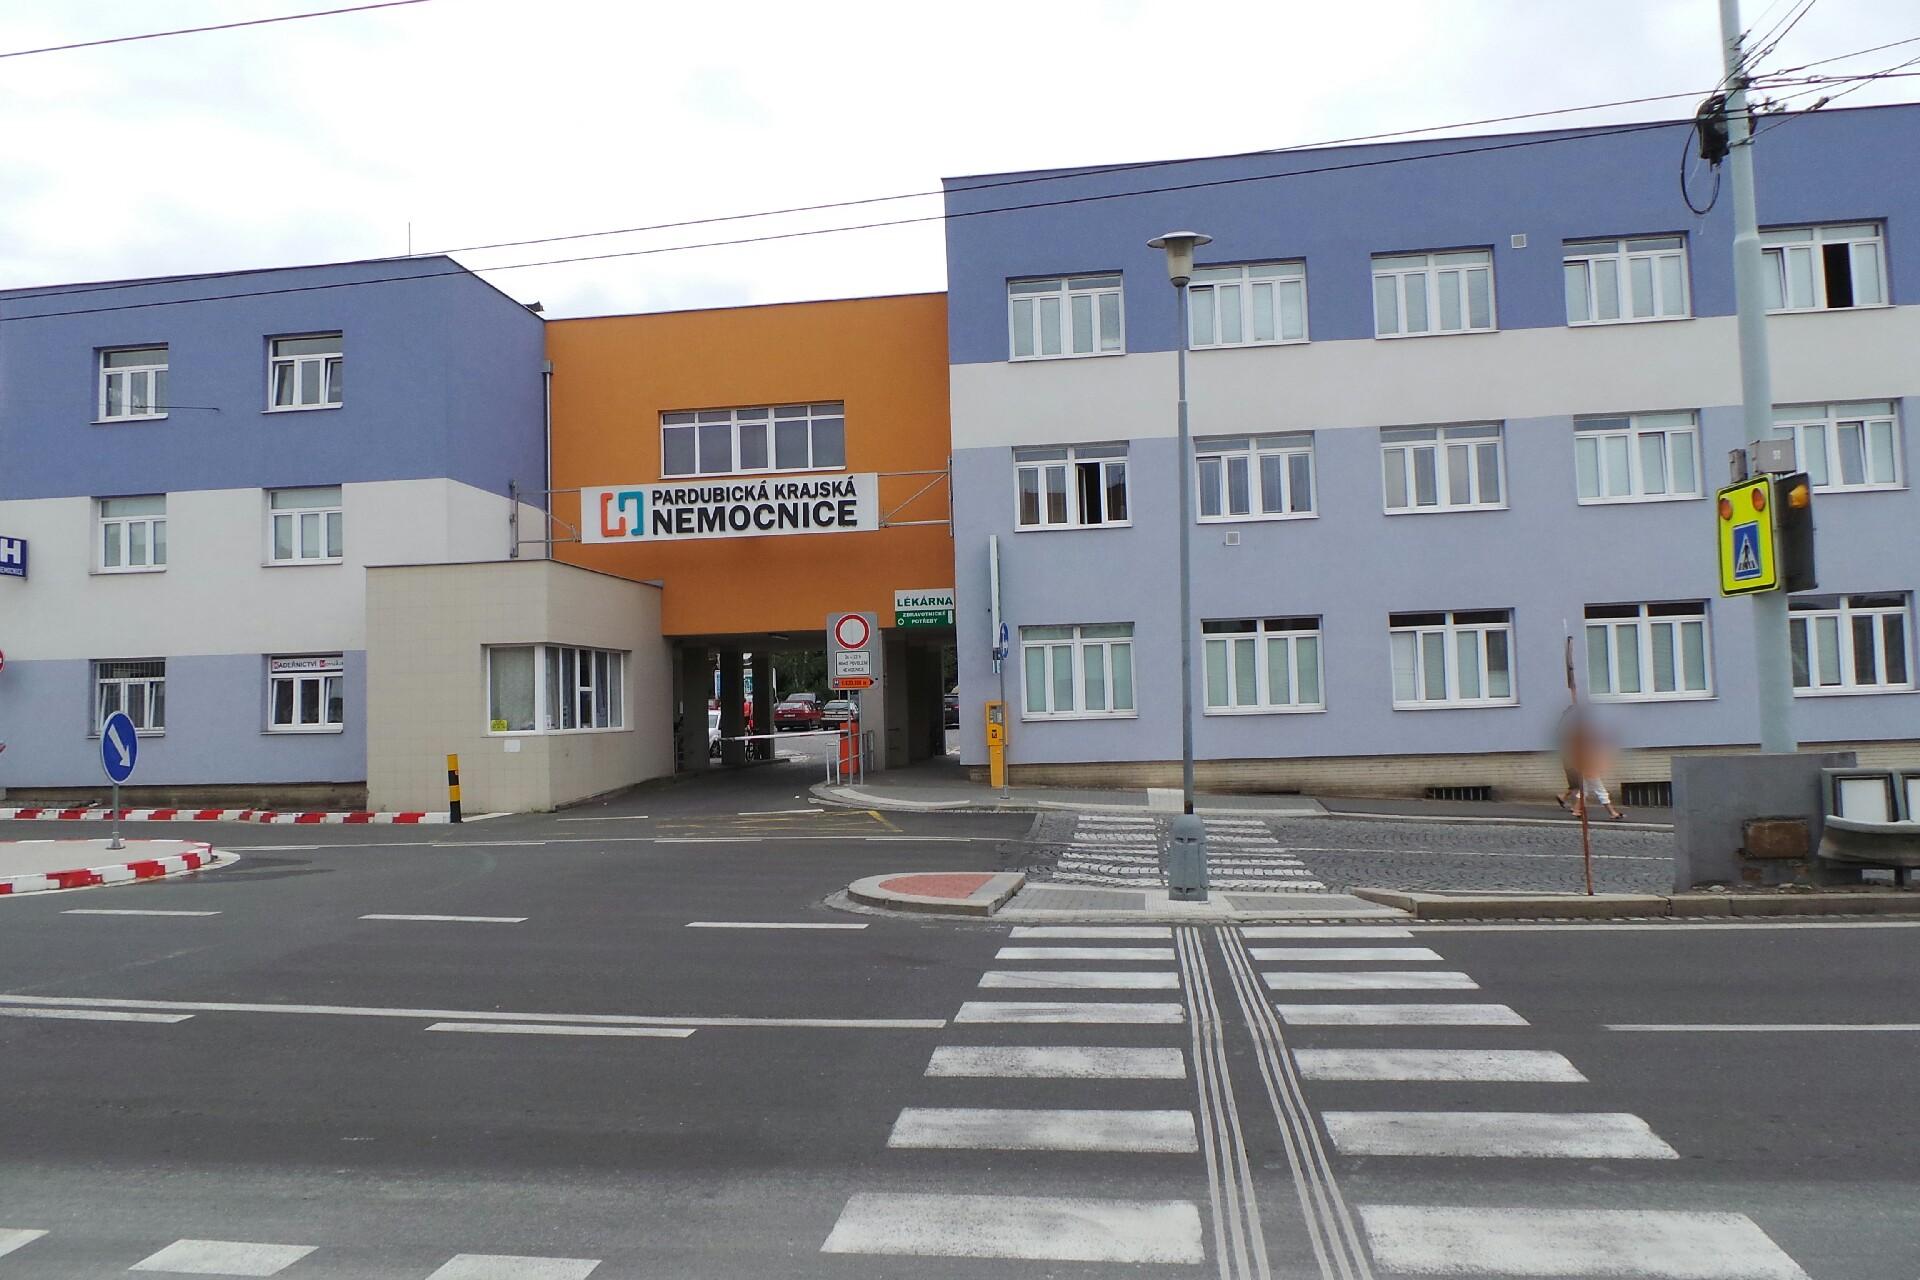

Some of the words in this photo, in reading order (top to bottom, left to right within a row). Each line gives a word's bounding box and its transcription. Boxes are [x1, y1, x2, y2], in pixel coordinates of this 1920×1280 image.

[652, 479, 769, 506] PARDUBICKÁ
[774, 475, 857, 501] KRAJSKÁ
[652, 500, 858, 536] NEMOCNICE
[1, 538, 21, 564] H
[897, 595, 954, 607] LÉKÁRNA
